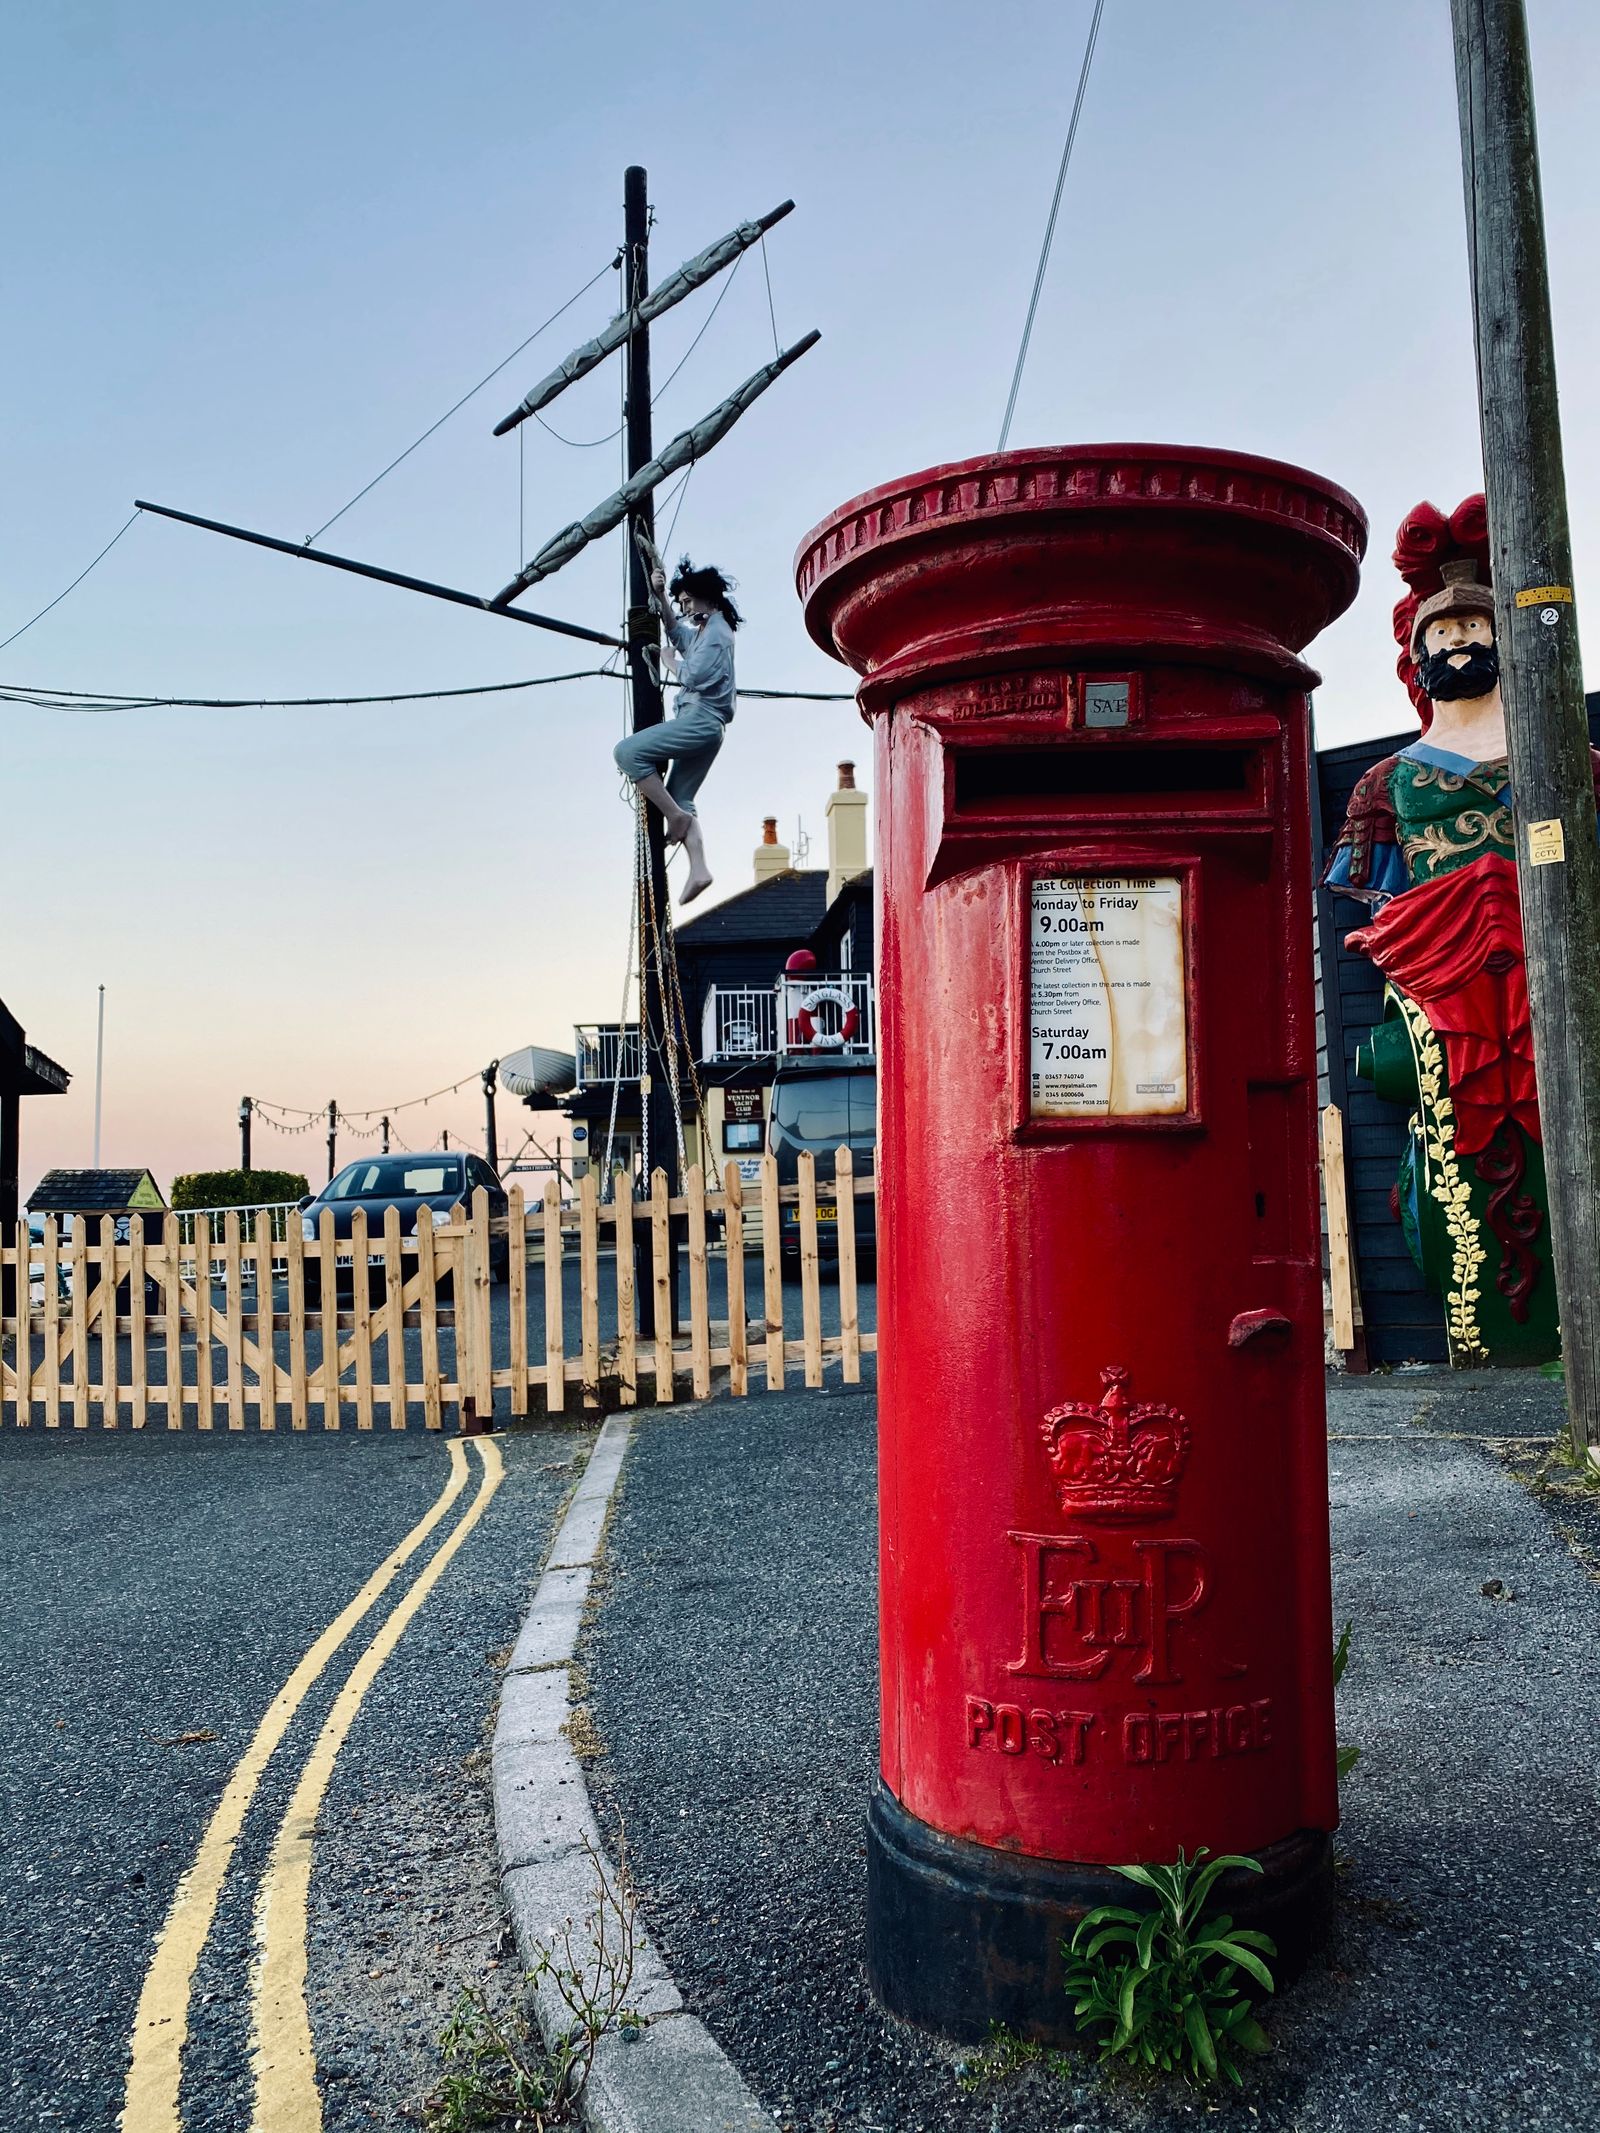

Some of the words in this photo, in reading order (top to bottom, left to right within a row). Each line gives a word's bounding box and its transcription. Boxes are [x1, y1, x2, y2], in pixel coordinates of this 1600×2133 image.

[1546, 610, 1555, 622] 2
[1534, 849, 1558, 858] CCTV
[1060, 879, 1120, 890] Collection
[1126, 879, 1156, 889] Time
[1032, 899, 1078, 911] Monday
[1083, 899, 1095, 909] to
[1100, 897, 1138, 910] Friday
[1040, 915, 1104, 933] 9.00am
[1035, 940, 1060, 948] 4.00pm
[1085, 939, 1114, 947] collection
[1055, 957, 1080, 965] Delivery
[1062, 981, 1090, 989] collection
[804, 990, 853, 1009] SPYGLASS
[1038, 991, 1062, 999] 5.30pm
[1056, 999, 1080, 1007] Delivery
[1032, 1027, 1089, 1039] Saturday
[820, 1036, 838, 1045] INN
[1042, 1043, 1106, 1060] 7.00am
[966, 1694, 1094, 1766] POST
[1122, 1697, 1273, 1764] OFFICE
